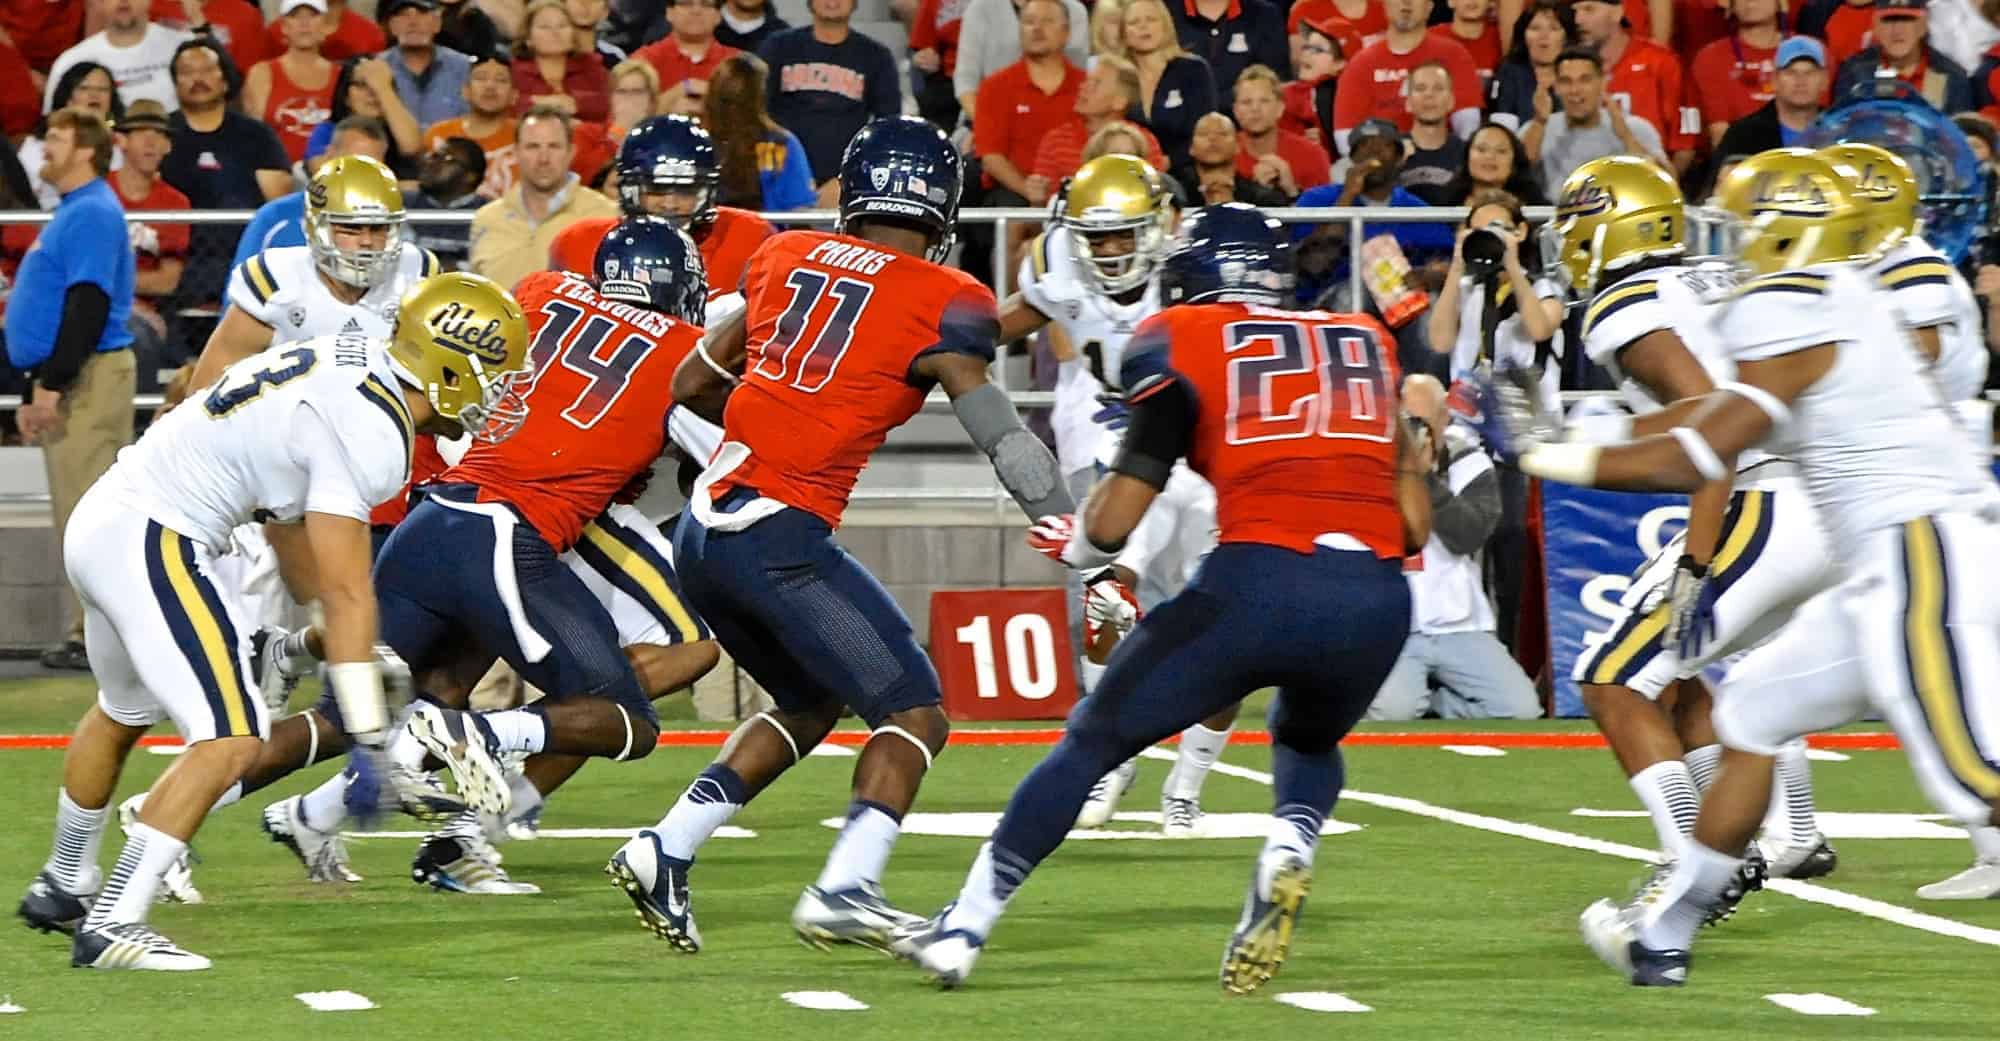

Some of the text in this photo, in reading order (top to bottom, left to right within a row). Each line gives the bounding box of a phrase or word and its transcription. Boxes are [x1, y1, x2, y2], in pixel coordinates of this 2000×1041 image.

[805, 239, 897, 276] PARKS
[1659, 215, 1673, 242] 3
[521, 299, 658, 430] 14
[752, 267, 874, 393] 11
[1222, 319, 1394, 445] 28
[956, 613, 1058, 700] 10
